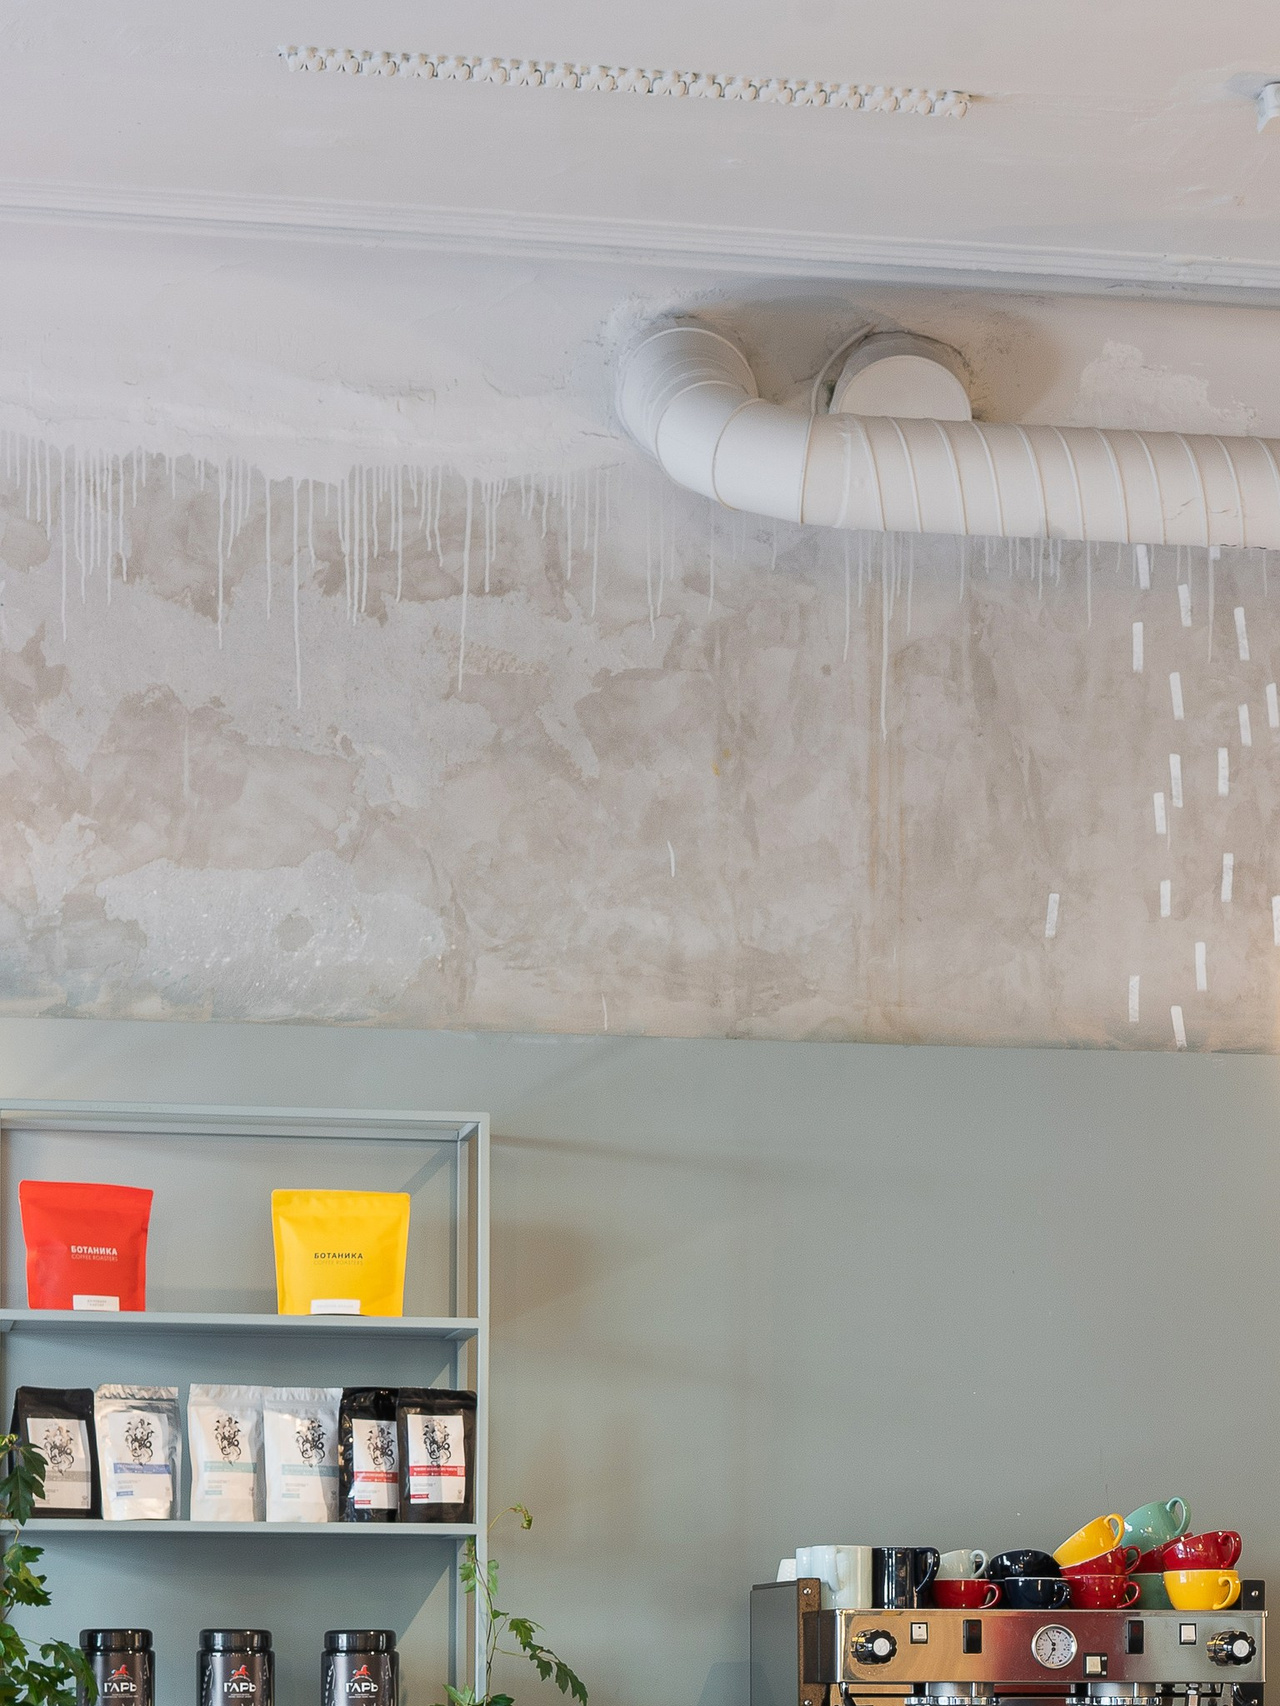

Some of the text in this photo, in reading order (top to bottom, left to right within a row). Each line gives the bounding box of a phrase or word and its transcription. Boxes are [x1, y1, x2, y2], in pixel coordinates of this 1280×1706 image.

[71, 1245, 118, 1255] БОТАНИКА
[104, 1682, 137, 1692] ГАРЬ
[223, 1682, 257, 1692] ГАРЬ
[345, 1682, 379, 1692] ГАРЬ
